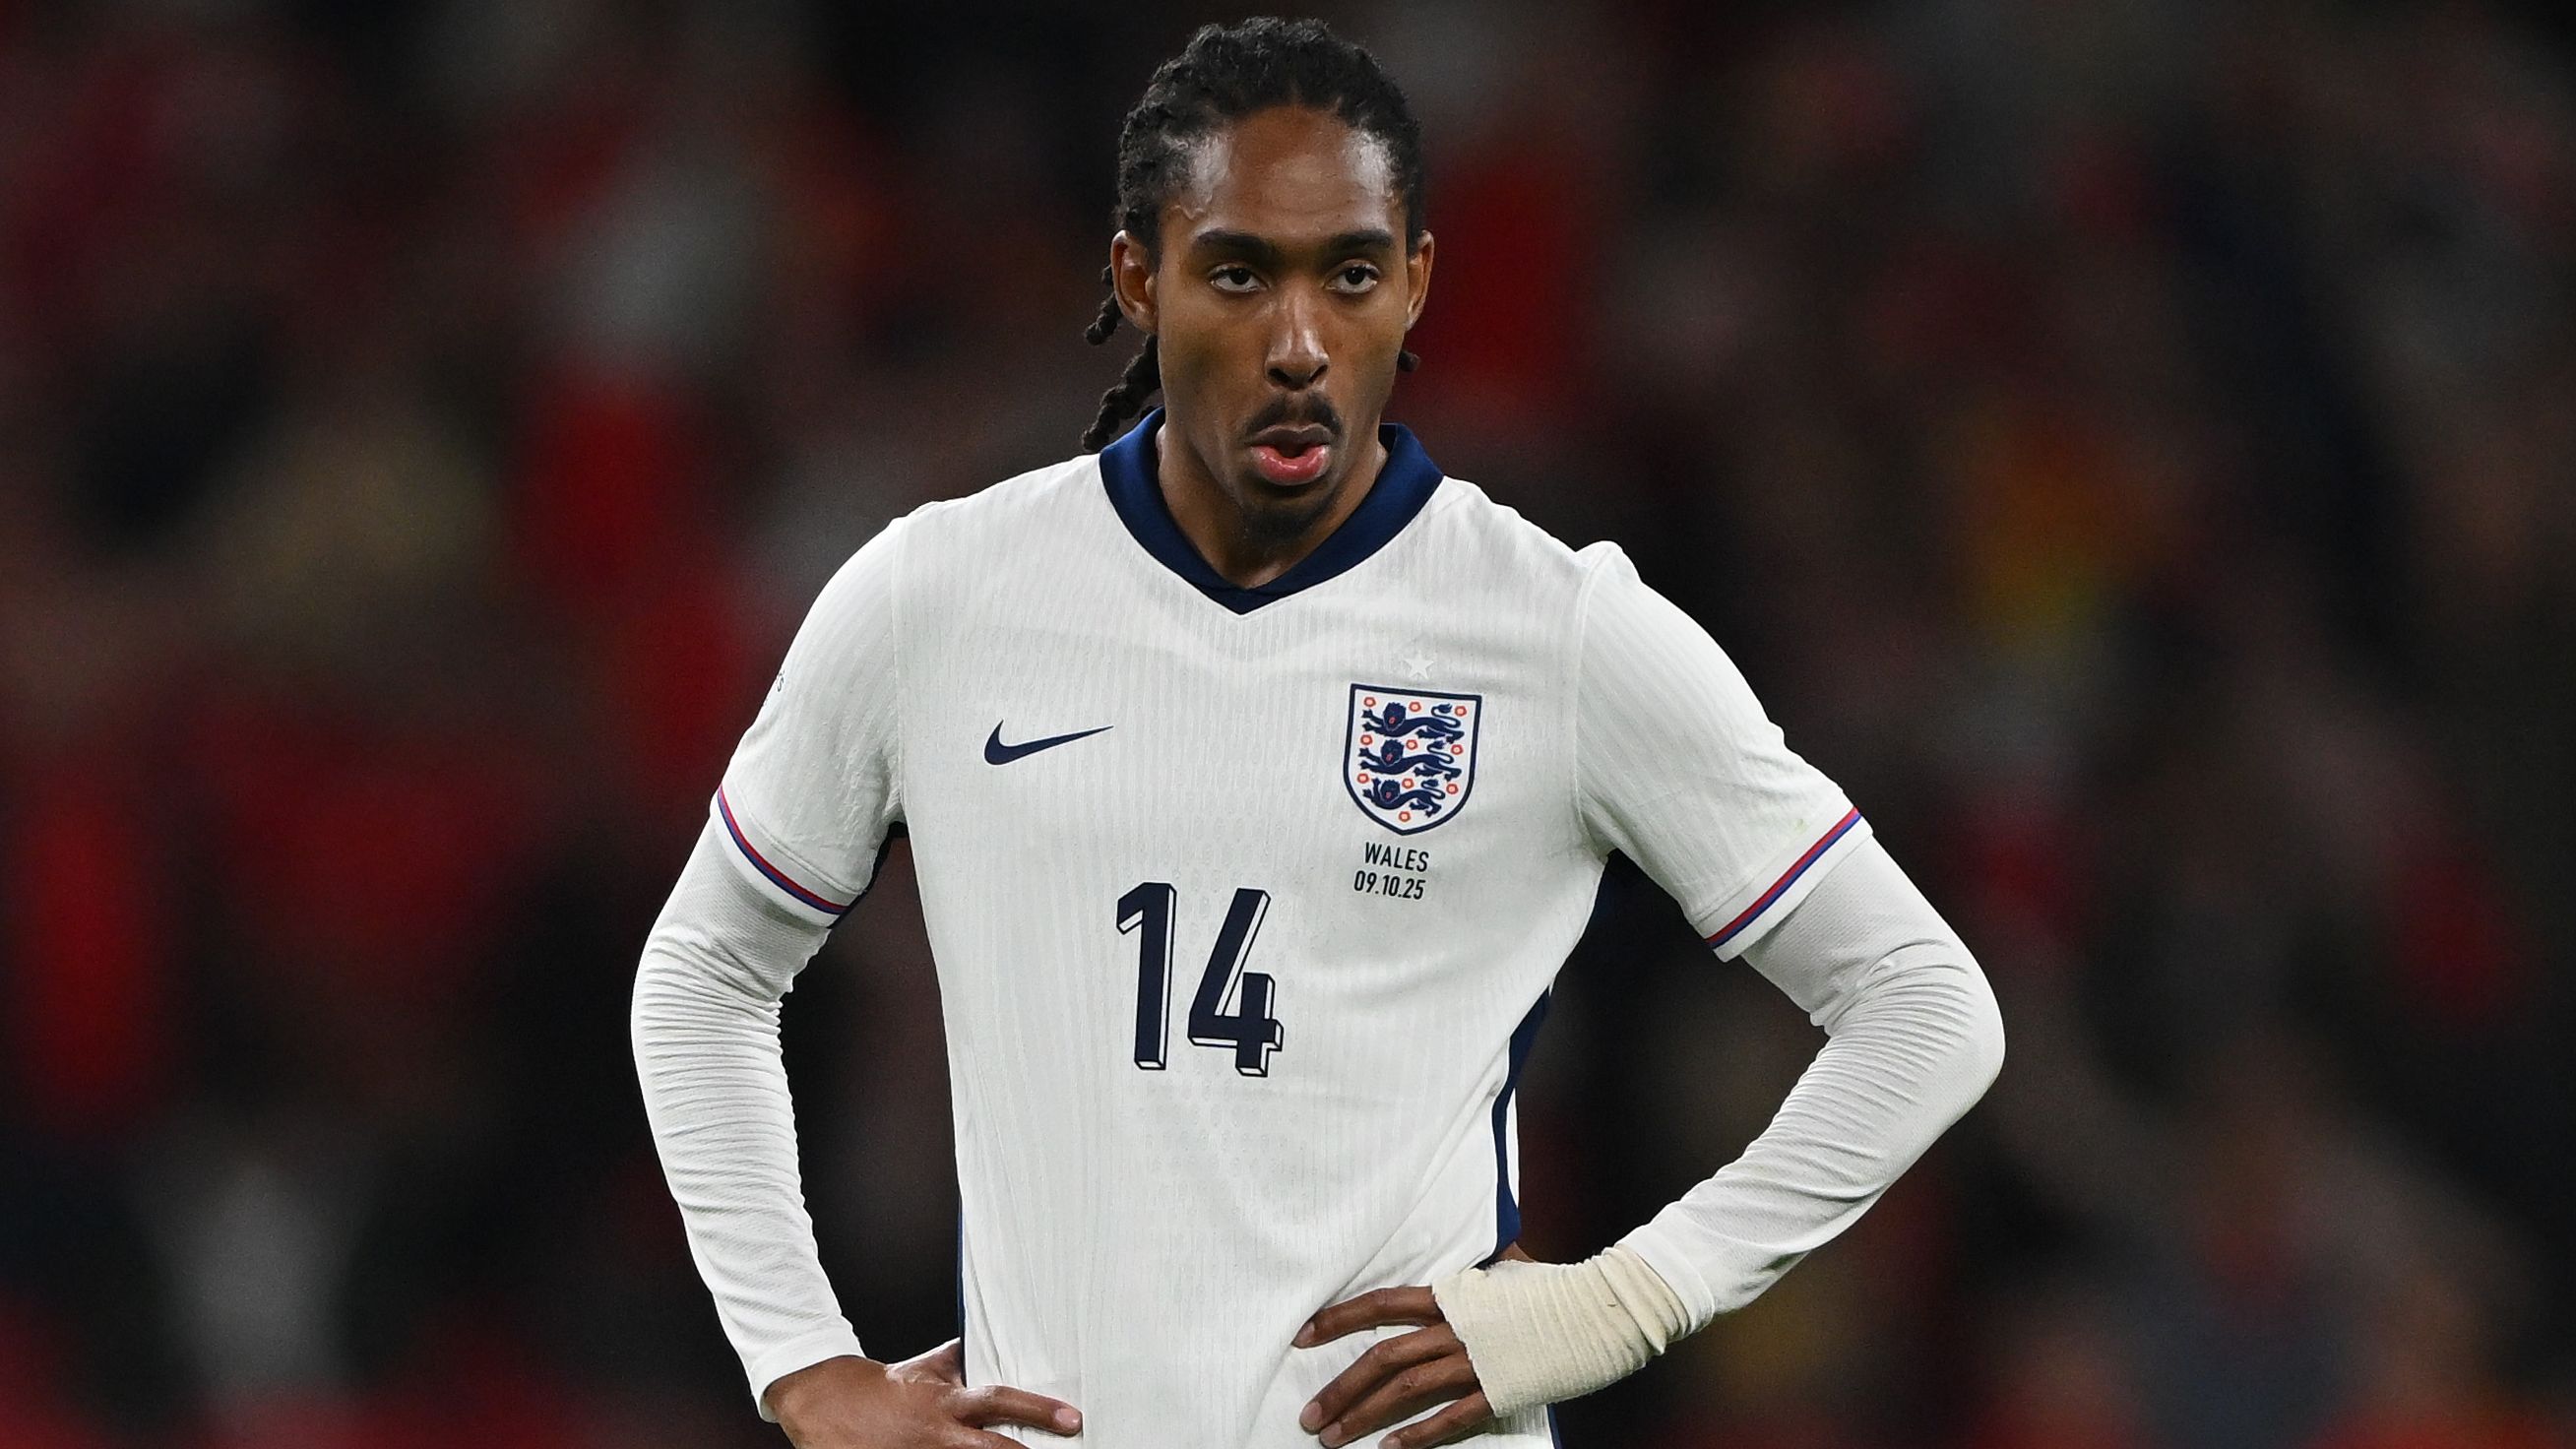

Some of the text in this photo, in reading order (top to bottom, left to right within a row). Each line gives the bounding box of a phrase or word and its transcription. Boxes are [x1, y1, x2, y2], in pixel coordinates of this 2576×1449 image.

[1365, 843, 1429, 872] WALES
[1354, 871, 1425, 900] 09.10.25
[1116, 882, 1284, 1077] 14
